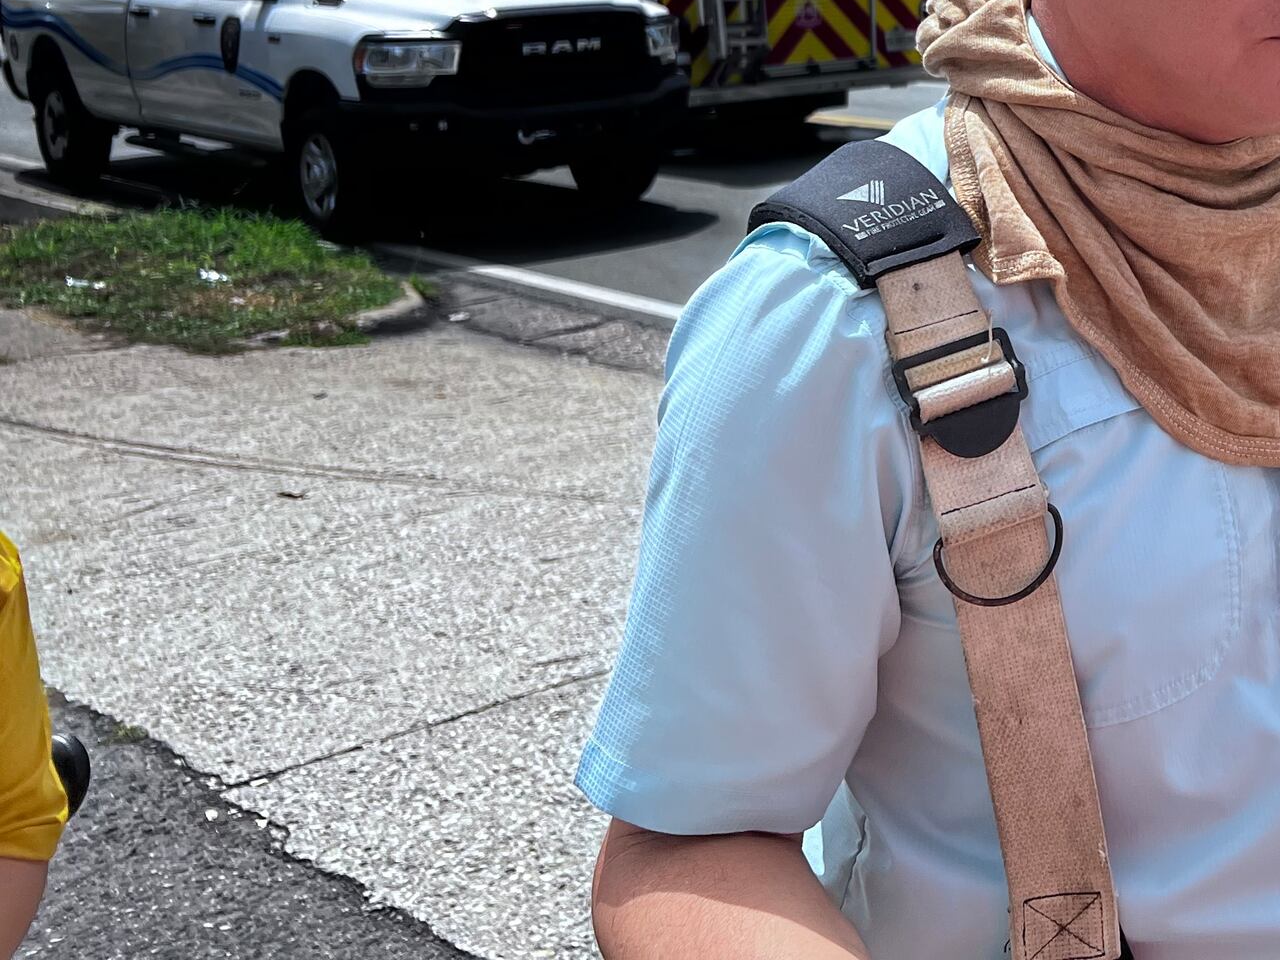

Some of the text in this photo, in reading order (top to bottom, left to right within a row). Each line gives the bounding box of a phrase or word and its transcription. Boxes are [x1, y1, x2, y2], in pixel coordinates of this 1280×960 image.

[522, 37, 602, 56] RAM
[841, 188, 939, 232] VERIDIAN
[866, 227, 882, 237] FIRE
